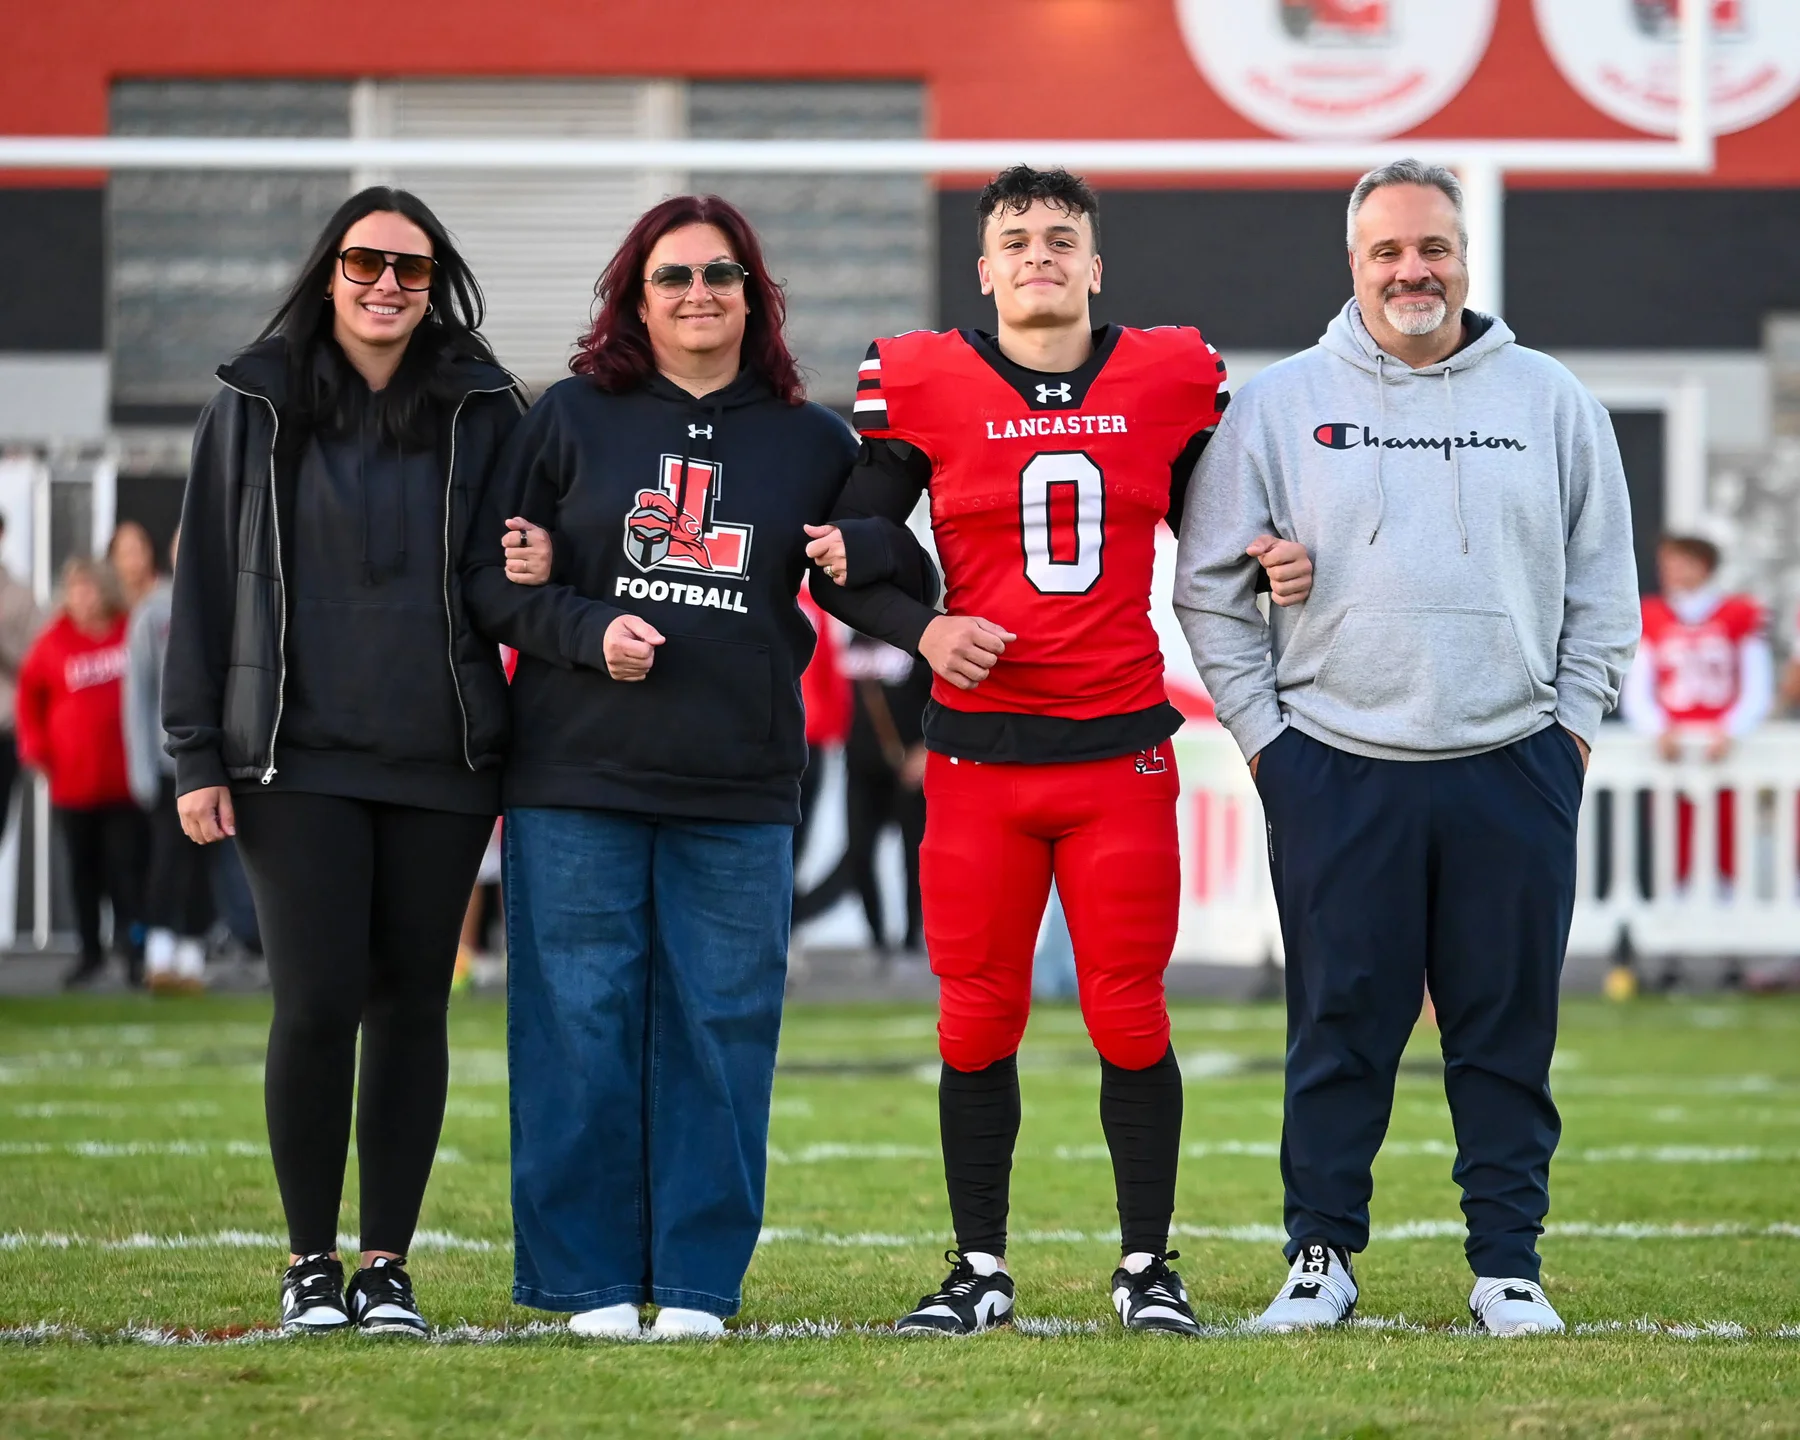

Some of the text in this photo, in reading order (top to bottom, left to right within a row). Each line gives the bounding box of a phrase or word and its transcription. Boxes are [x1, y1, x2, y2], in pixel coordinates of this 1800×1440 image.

[986, 415, 1128, 440] LANCASTER
[1313, 422, 1527, 461] Champion
[1019, 450, 1105, 596] 0
[615, 576, 748, 614] FOOTBALL
